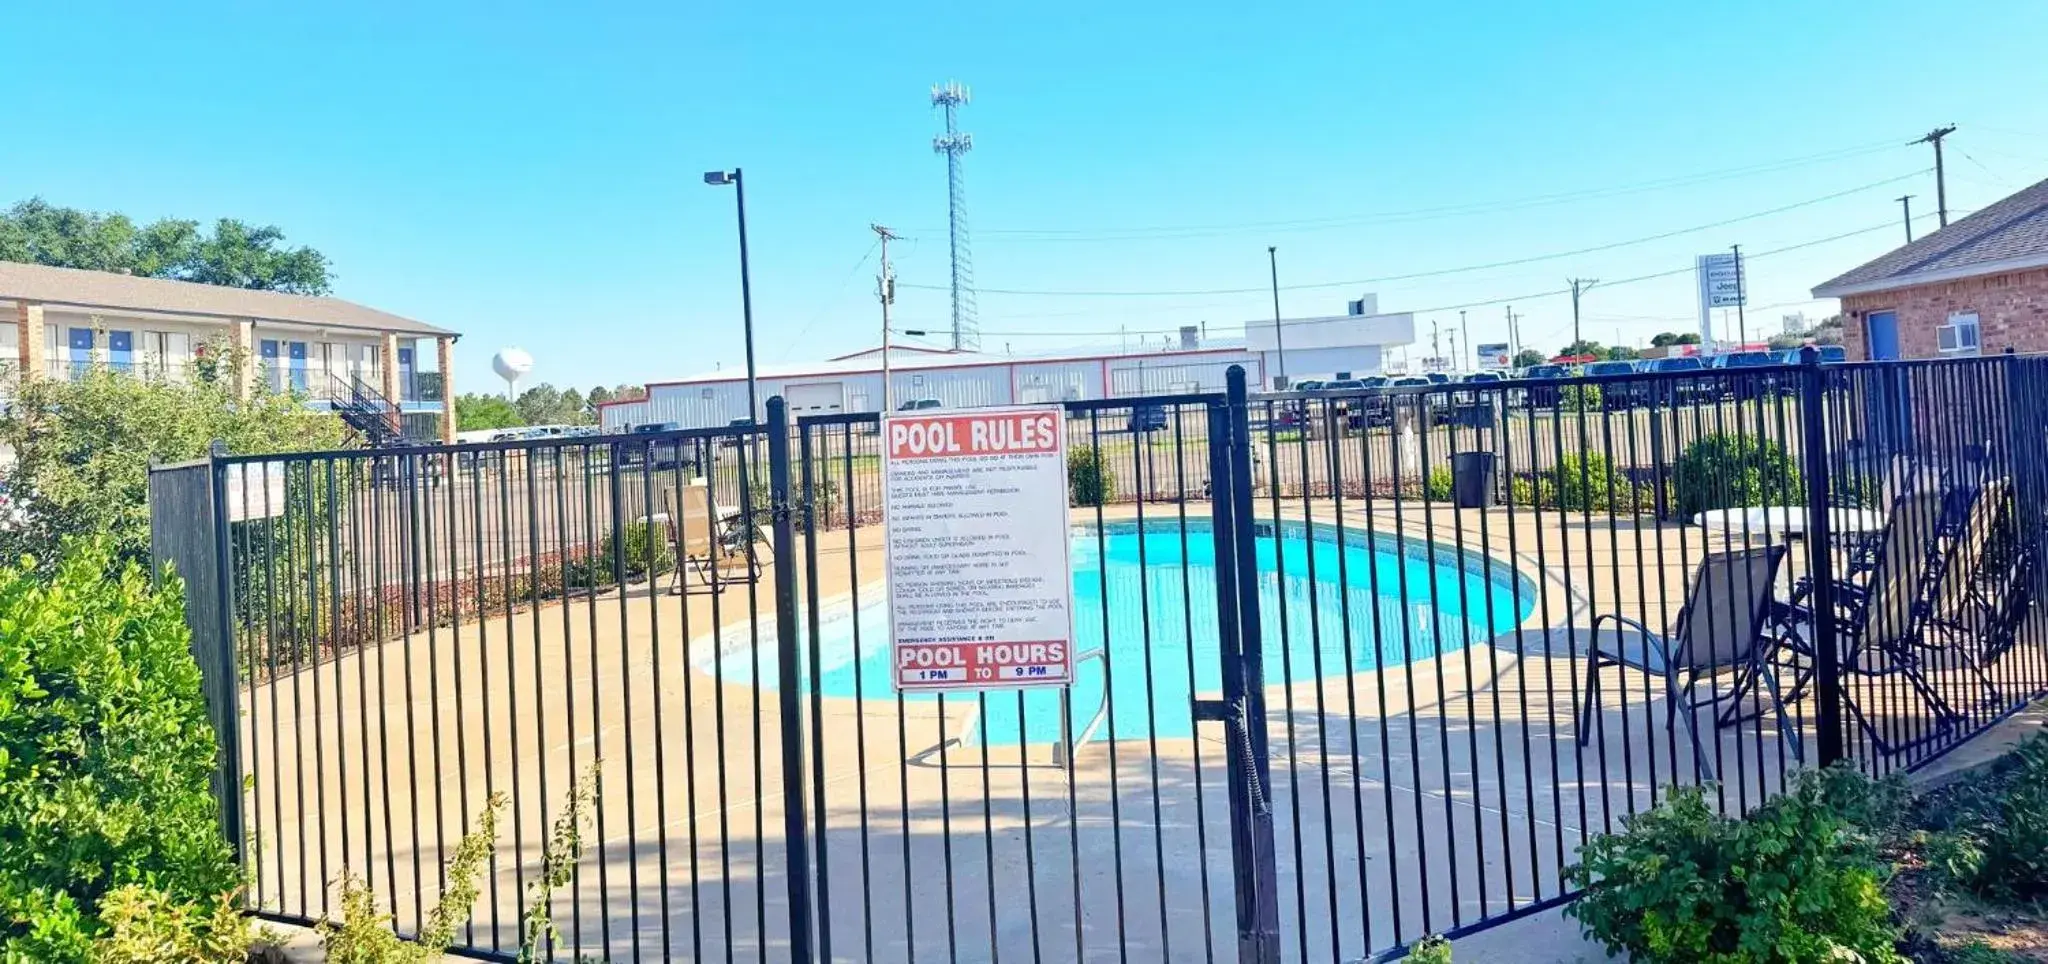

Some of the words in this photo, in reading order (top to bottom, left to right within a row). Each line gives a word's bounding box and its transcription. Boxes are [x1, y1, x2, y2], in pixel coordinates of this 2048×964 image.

[892, 422, 961, 455] POOL
[972, 416, 1054, 452] RULES
[900, 647, 967, 667] POOL
[976, 643, 1065, 664] HOURS
[919, 672, 926, 680] 1
[930, 670, 948, 679] PM
[975, 668, 992, 679] TO
[1015, 667, 1024, 676] 9
[1028, 666, 1047, 675] PM
